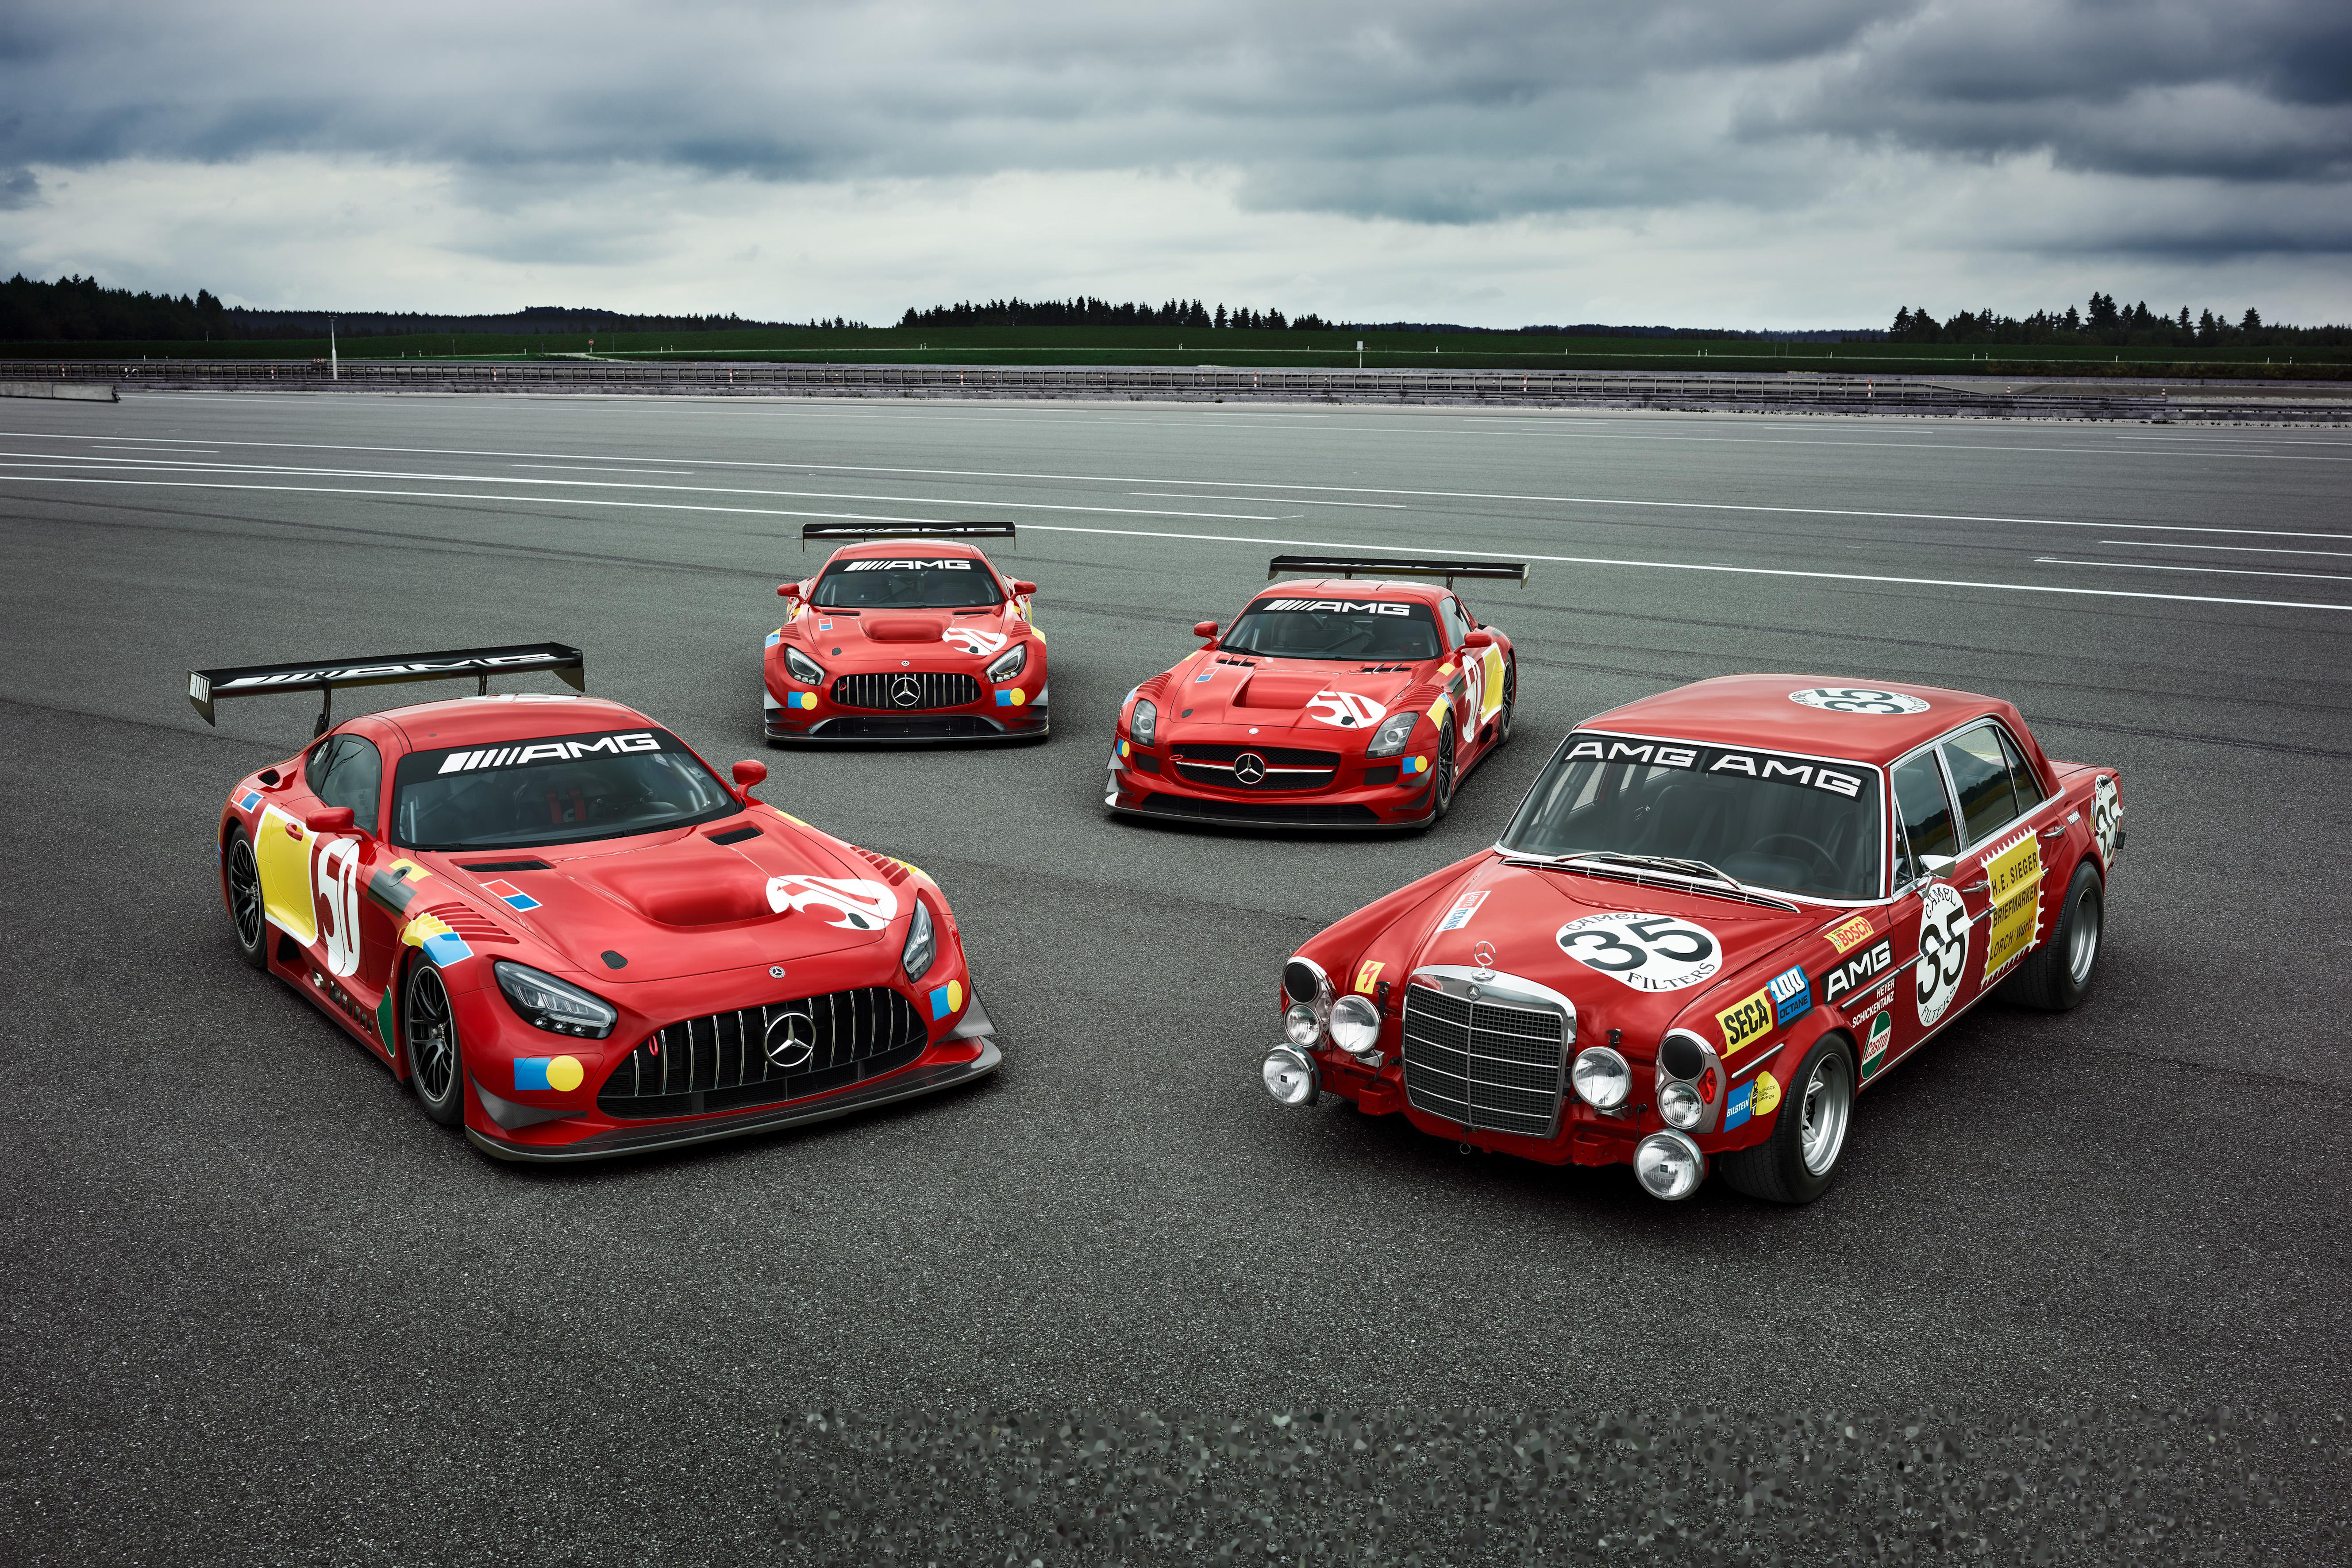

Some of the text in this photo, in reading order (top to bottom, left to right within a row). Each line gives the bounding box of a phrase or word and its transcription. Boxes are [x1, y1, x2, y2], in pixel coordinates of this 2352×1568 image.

[884, 560, 971, 570] AMG
[1306, 601, 1410, 616] AMG
[1306, 690, 1387, 729] 50
[1462, 655, 1481, 743] 50
[1791, 692, 1818, 705] CAMEL
[1814, 689, 1905, 713] 35
[516, 733, 661, 764] AMG
[1565, 742, 1862, 797] AMG AMG
[2010, 851, 2037, 884] SIEGER
[317, 838, 360, 977] 50
[1925, 887, 1956, 919] CAMEL
[1993, 882, 2038, 928] BRIEFMARKEN
[1566, 913, 1648, 931] CAMEL
[1836, 919, 1872, 947] BOSCH
[1560, 917, 1713, 971] 35
[1917, 905, 1966, 1004] 35
[1626, 963, 1715, 990] FILTERS
[1770, 968, 1807, 1005] 100
[1827, 940, 1891, 1002] AMG
[1877, 978, 1895, 999] HEYER
[1921, 985, 1956, 1023] FILTERS
[1724, 998, 1770, 1045] SECA
[1780, 995, 1808, 1019] OCTANE
[1852, 990, 1894, 1029] SCHICKENTANZ
[1865, 1028, 1890, 1060] Castrol
[1726, 1098, 1749, 1117] BILSTEIN
